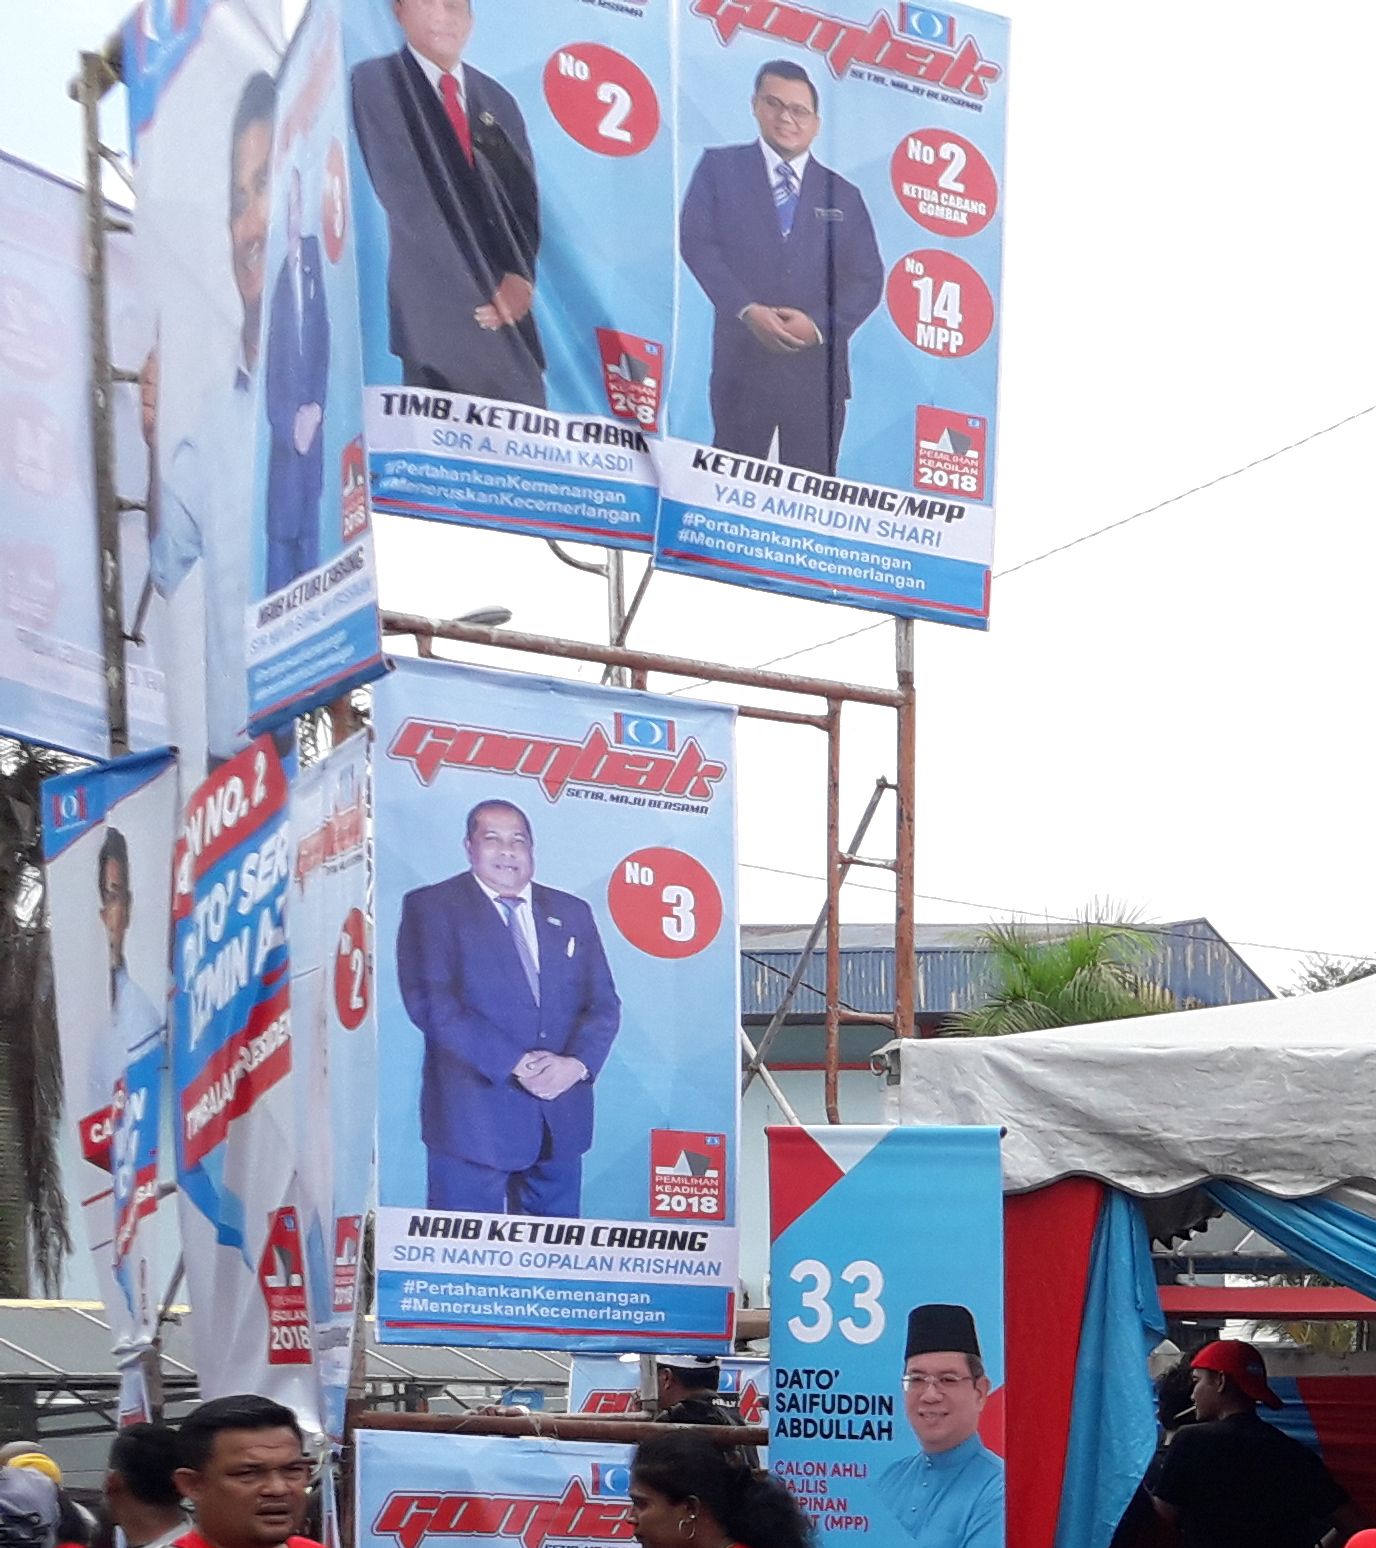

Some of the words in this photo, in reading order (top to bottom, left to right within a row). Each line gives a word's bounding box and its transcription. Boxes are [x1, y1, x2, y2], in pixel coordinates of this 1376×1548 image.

[597, 82, 632, 143] 2
[938, 142, 967, 193] 2
[902, 182, 939, 204] KETUA
[940, 191, 987, 216] CABANG
[918, 201, 968, 225] GOMBAK
[912, 276, 963, 330] 14
[916, 322, 964, 354] MPP
[380, 392, 460, 423] TIMB.
[466, 404, 560, 438] KETUA
[566, 421, 650, 454] CABAN
[432, 429, 473, 450] SDR
[505, 440, 573, 464] RAHIM
[579, 449, 634, 472] KASDI
[692, 448, 783, 489] KETUA
[787, 471, 967, 524] CABANG/MPP
[919, 467, 977, 492] 2018
[715, 484, 756, 509] YAB
[762, 495, 870, 534] AMIRUDIN
[877, 519, 943, 548] SHARI
[681, 511, 912, 573] #PertahankanKemenangan
[678, 528, 926, 591] #MeneruskanKecemerlangan
[610, 793, 646, 807] MAJU
[662, 884, 696, 942] 3
[350, 947, 365, 1010] 2
[655, 1175, 719, 1186] PEMILIHAN
[655, 1184, 719, 1196] KEADILAN
[655, 1194, 719, 1214] 2018
[408, 1215, 483, 1240] NAIB
[487, 1219, 584, 1247] KETUA
[591, 1226, 709, 1252] CABANG
[394, 1244, 435, 1263] SDR
[441, 1247, 514, 1268] NANTO
[519, 1251, 613, 1272] GOPALAN
[619, 1255, 722, 1277] KRISHNAN
[403, 1279, 651, 1306] #PertahankanKemenangan
[788, 1259, 886, 1345] 33
[400, 1298, 666, 1324] #MeneruskanKecemerlangan
[272, 1325, 312, 1350] 2018
[776, 1368, 840, 1390] DATO'
[775, 1392, 893, 1416] SAIFUDDIN
[775, 1418, 893, 1441] ABDULLAH
[775, 1460, 826, 1477] CALON
[831, 1462, 867, 1478] AHLI
[797, 1497, 847, 1512] PINAN
[824, 1514, 869, 1532] (MPP)
